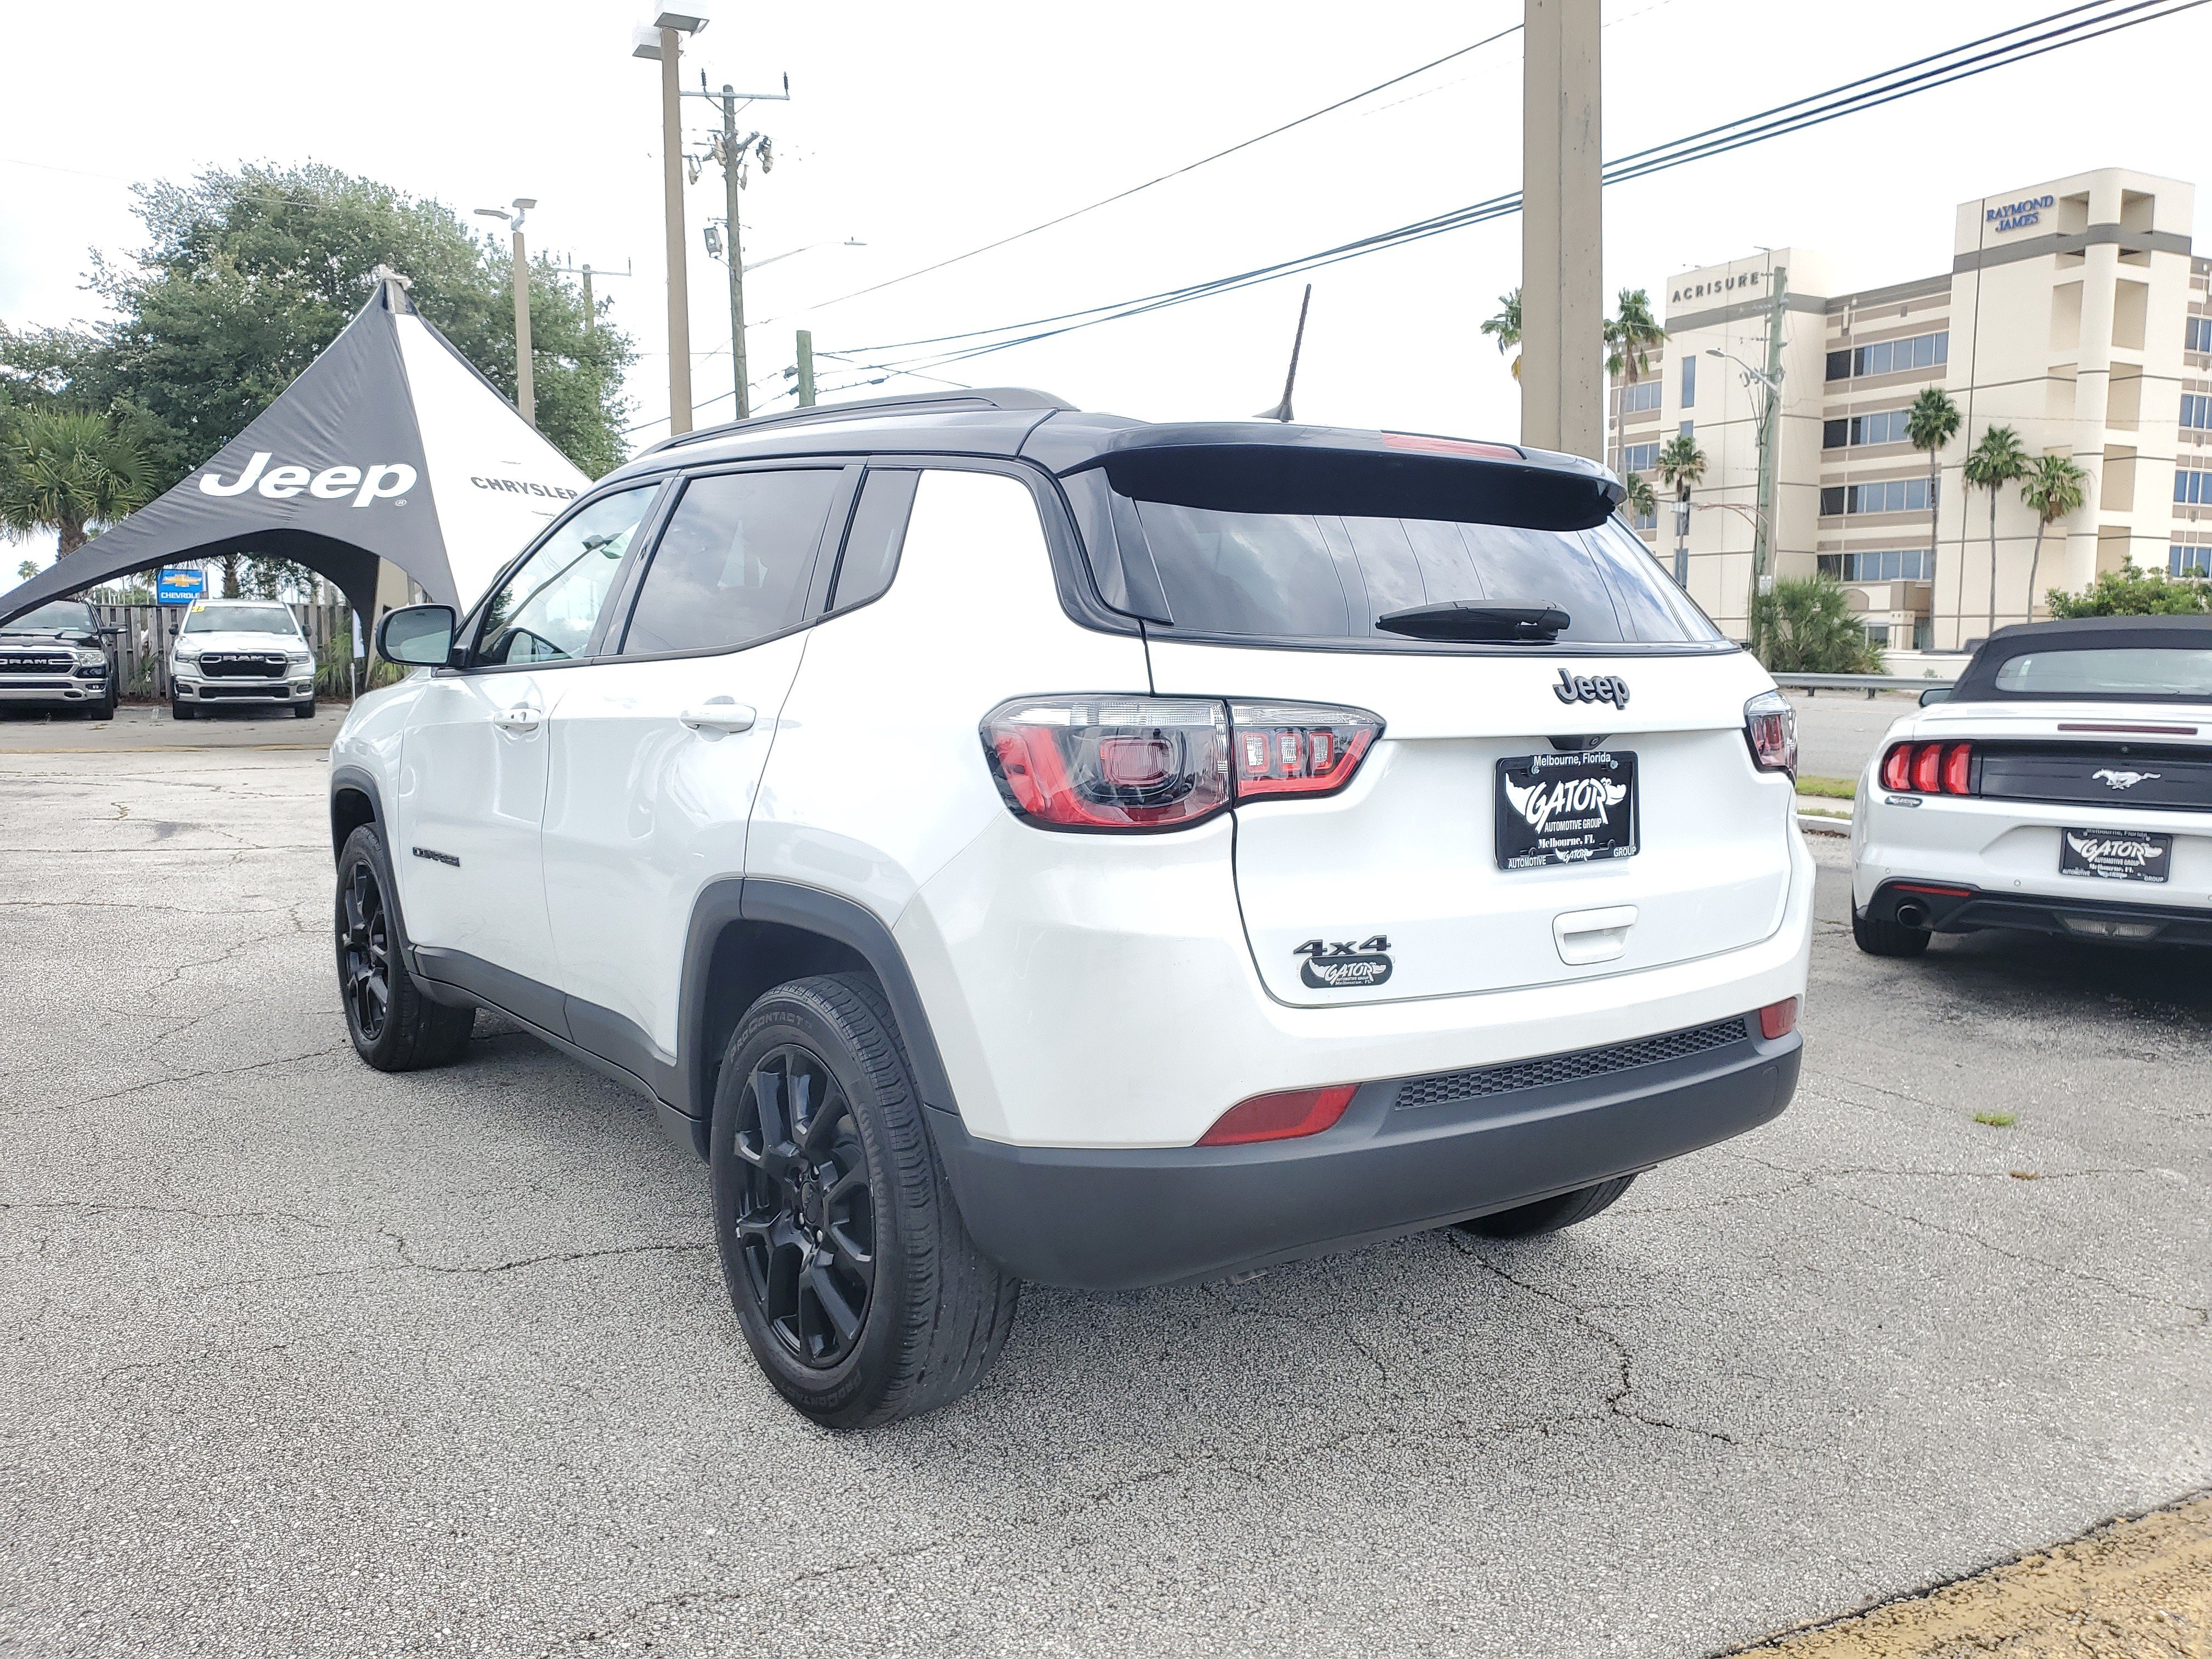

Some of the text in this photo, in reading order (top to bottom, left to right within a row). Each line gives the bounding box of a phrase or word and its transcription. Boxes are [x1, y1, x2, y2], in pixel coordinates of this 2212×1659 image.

[1986, 195, 2054, 222] RAYMOND
[1995, 212, 2039, 232] JAMES
[1672, 272, 1759, 302] ACRISURE
[199, 452, 418, 508] Jeep
[1552, 668, 1630, 710] Jeep
[1533, 752, 1611, 766] Melbourne, Florida
[1526, 777, 1609, 834] GATOR
[1544, 817, 1602, 832] AUTOMOTIVE GROUP
[1538, 834, 1595, 849] Melbourne, FL
[2081, 838, 2146, 866] GATOR
[1508, 847, 1637, 869] AUTOMOTIVE GATOR GROUP
[2095, 857, 2123, 865] AUTOMOTIVE
[1294, 934, 1392, 956] 4x4
[1325, 962, 1374, 985] GATOR
